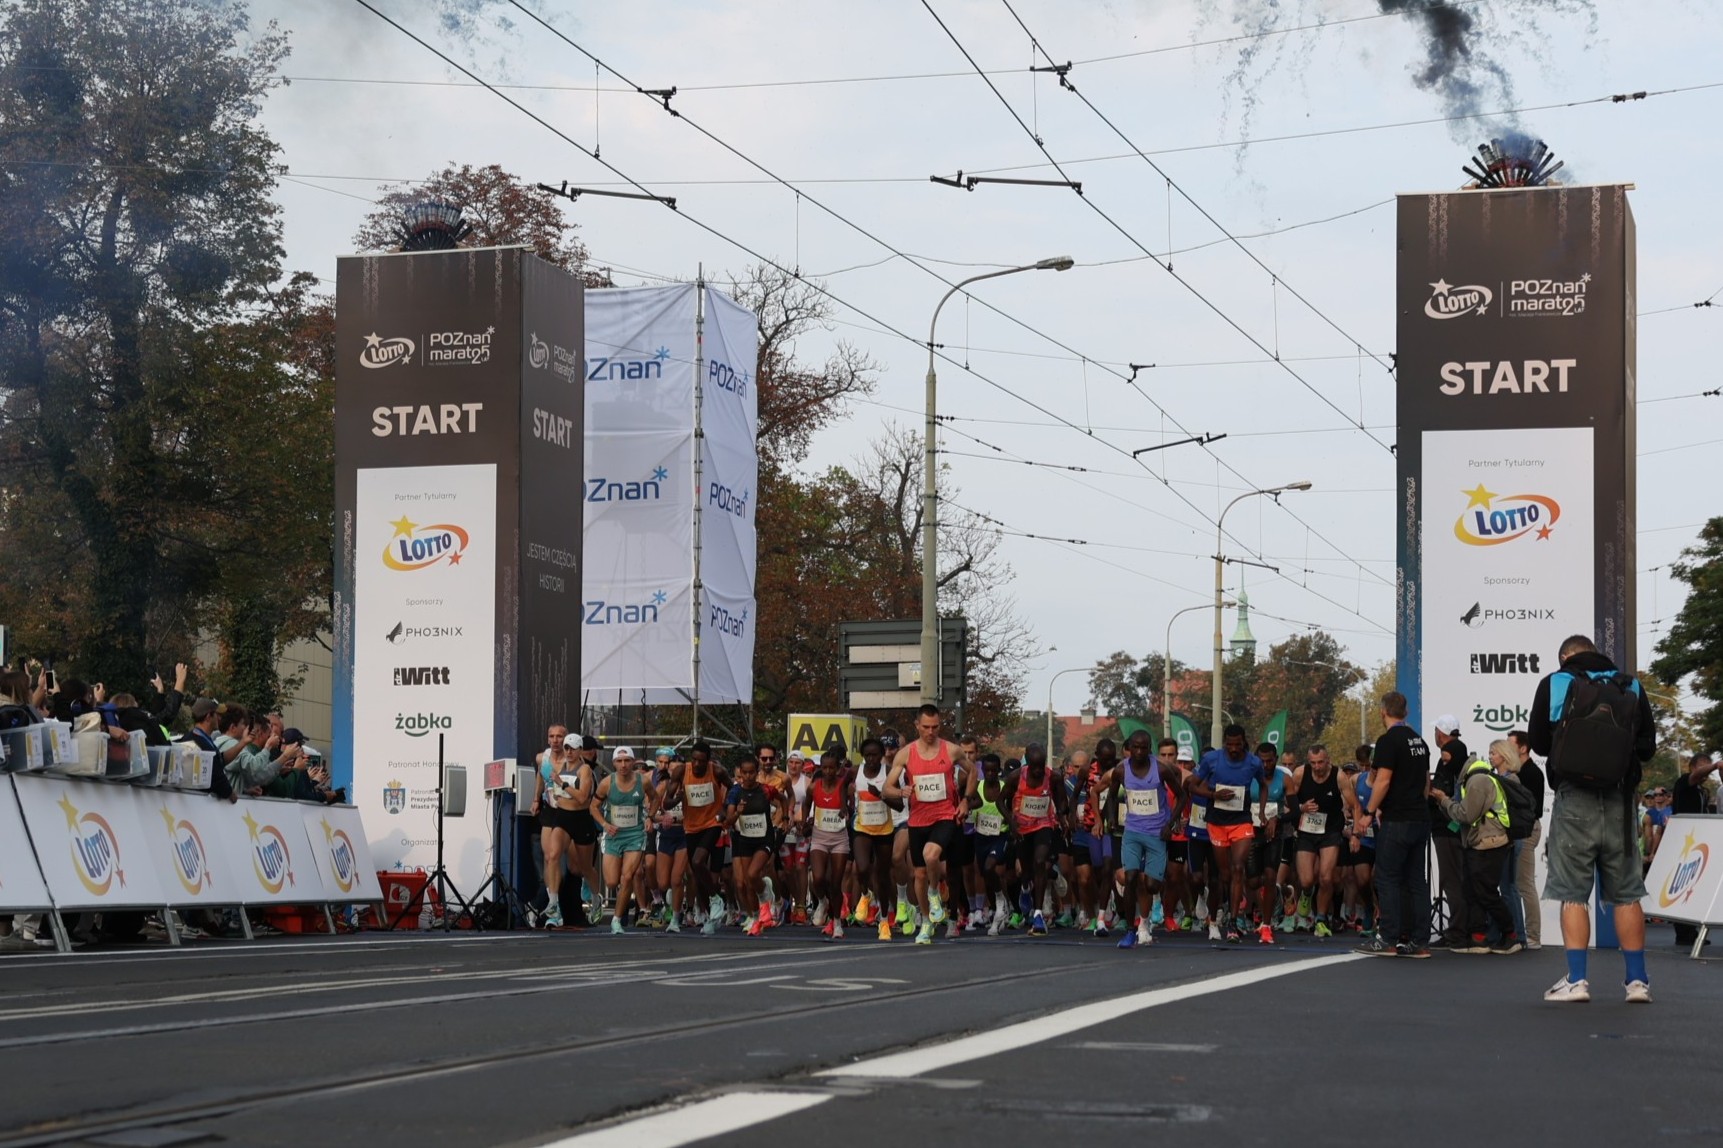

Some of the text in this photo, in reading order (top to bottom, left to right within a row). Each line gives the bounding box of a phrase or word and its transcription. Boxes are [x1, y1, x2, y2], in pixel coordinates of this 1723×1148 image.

[1438, 291, 1479, 313] LOTTO
[370, 343, 405, 363] LOTTO
[1439, 359, 1577, 396] START
[371, 403, 483, 437] START
[533, 407, 573, 449] START
[1468, 459, 1545, 468] Partner Tytularny
[424, 492, 457, 501] Tytularny
[1475, 503, 1540, 536] LOTTO
[399, 533, 452, 562] LOTTO
[526, 542, 577, 573] JESTEM CZĘŚCIĄ
[539, 572, 565, 593] HISTORII
[1483, 576, 1530, 586] Sponsorzy
[405, 598, 443, 606] Sponsorzy
[1479, 653, 1540, 674] Witt
[401, 667, 450, 686] Witt
[395, 712, 452, 729] żabka
[1473, 704, 1529, 722] żabk
[791, 723, 848, 751] AA
[852, 724, 864, 753] AA
[918, 783, 940, 792] PACE
[1132, 798, 1153, 806] PACE
[744, 822, 763, 830] DEME
[1306, 816, 1323, 826] 3762
[75, 828, 111, 879] LOTTO
[401, 839, 444, 847] Organizat
[174, 835, 201, 880] LOTTO
[256, 838, 284, 880] LOTTO
[331, 841, 351, 880] LOTTO
[1668, 857, 1702, 895] LOTTO
